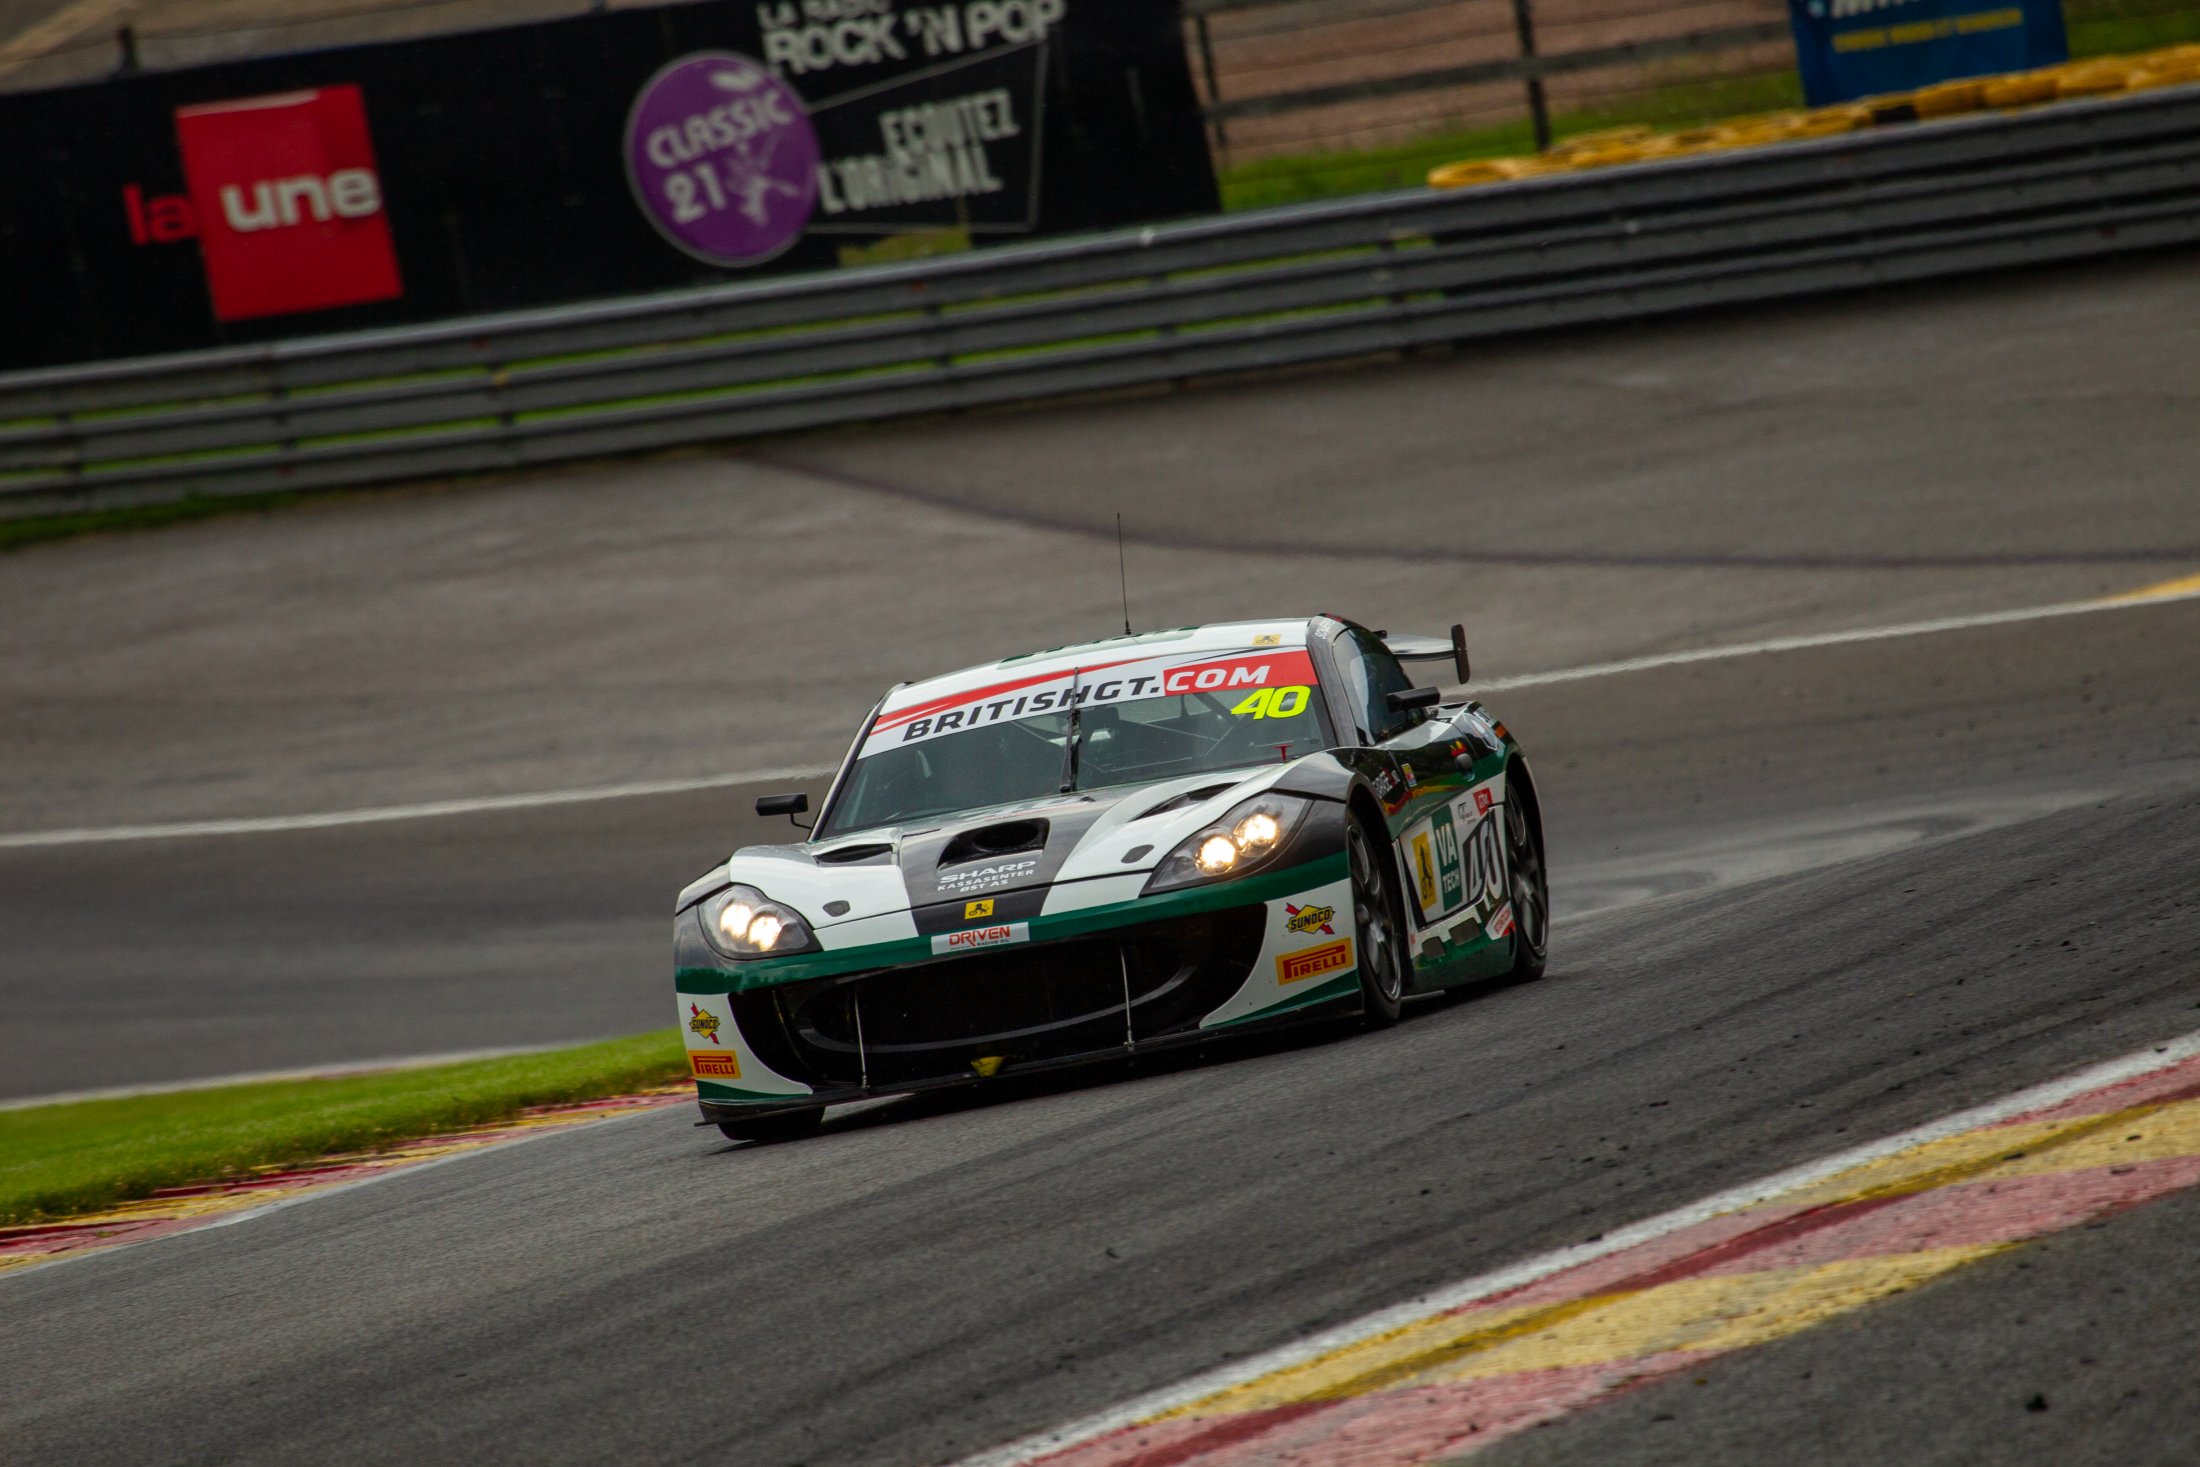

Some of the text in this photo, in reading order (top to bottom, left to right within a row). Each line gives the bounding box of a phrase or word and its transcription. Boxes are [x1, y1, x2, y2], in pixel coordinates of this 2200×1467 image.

[763, 15, 909, 78] ROCK
[965, 0, 1067, 49] POP
[647, 90, 794, 168] CLASSIC
[122, 168, 382, 246] la une
[664, 162, 727, 225] 21
[902, 664, 1271, 742] BRITISHGT.COM
[1230, 685, 1311, 720] 40
[939, 860, 1036, 884] SHARP
[1469, 818, 1503, 901] 40
[937, 869, 1034, 892] KASSASENTER
[991, 879, 1009, 888] AS
[949, 926, 1011, 947] DRIVEN
[1290, 909, 1331, 930] SUNOCO
[1282, 944, 1346, 980] PIRELLI
[691, 1019, 718, 1030] SUNOCO
[692, 1055, 736, 1075] PIRELLI
